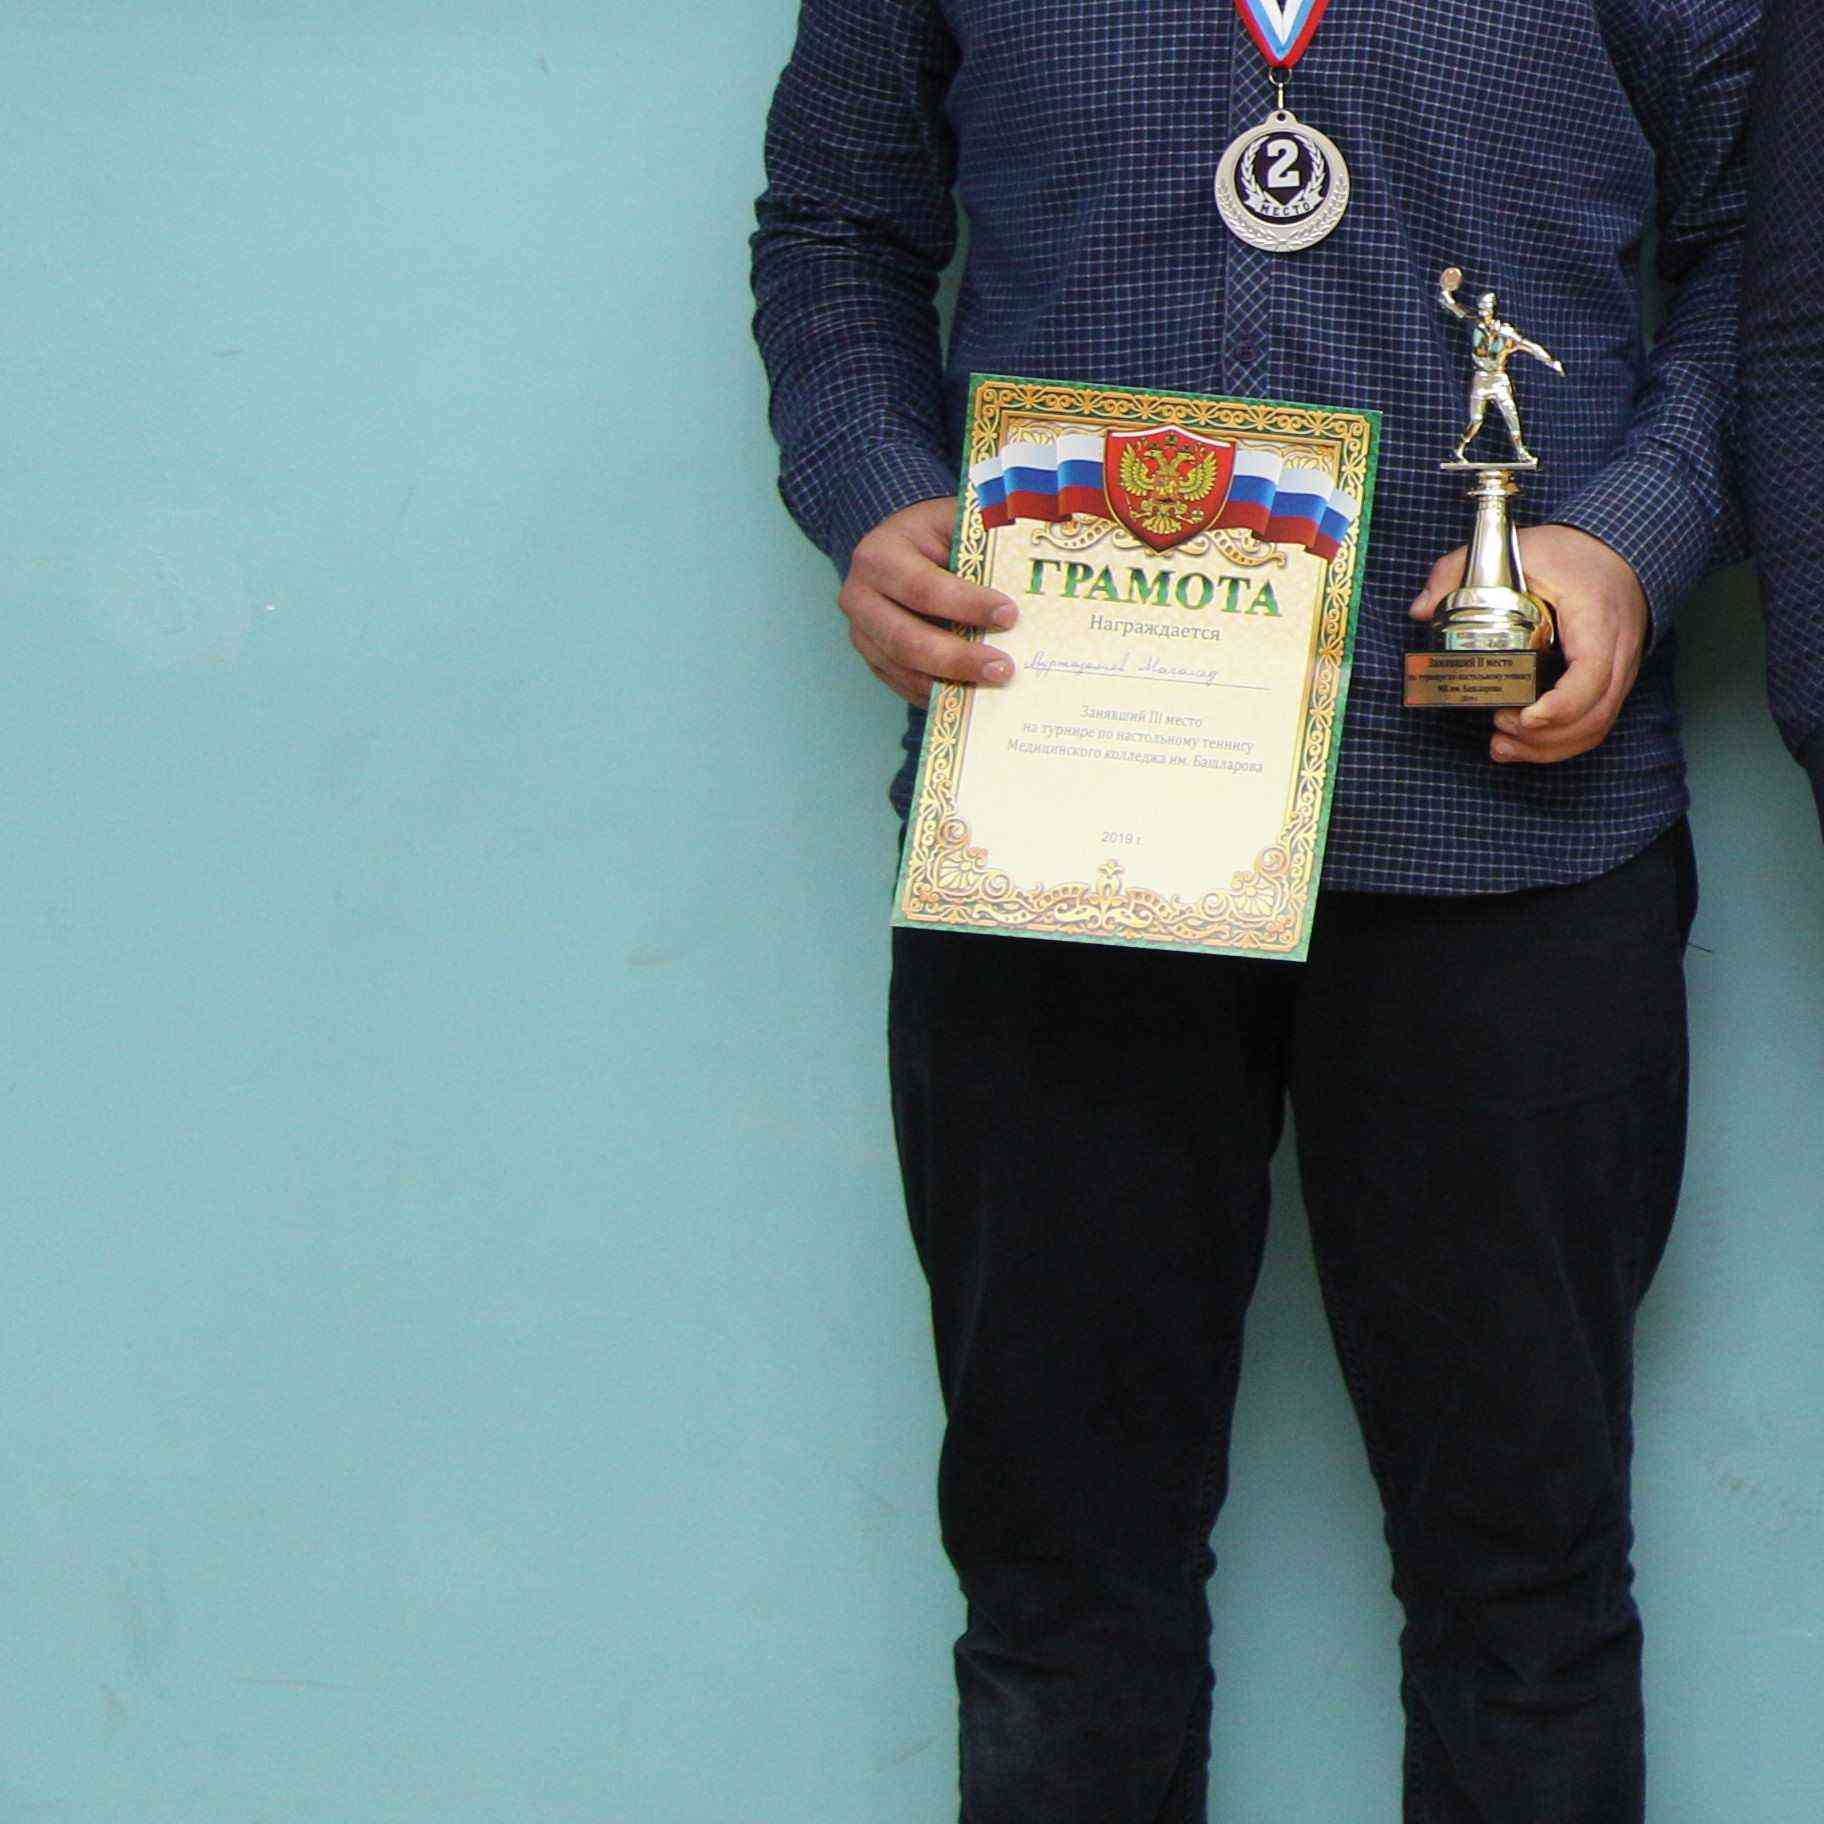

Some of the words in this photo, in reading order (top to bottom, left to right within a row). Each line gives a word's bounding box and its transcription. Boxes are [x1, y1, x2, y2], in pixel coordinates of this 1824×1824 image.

[1266, 138, 1301, 189] 2
[1260, 201, 1311, 217] МЕСТО
[1023, 557, 1284, 619] ГРАМОТА
[1089, 613, 1222, 643] Награждается
[1079, 704, 1146, 723] Занявший
[1165, 714, 1203, 728] место
[1022, 720, 1038, 733] на
[1042, 723, 1095, 740] турнире
[1097, 727, 1113, 741] по
[1116, 729, 1202, 751] настольному
[1203, 736, 1255, 755] теннису
[1006, 737, 1102, 760] Медицинского
[1104, 749, 1167, 768] колледжа
[1192, 754, 1264, 775] Башларова
